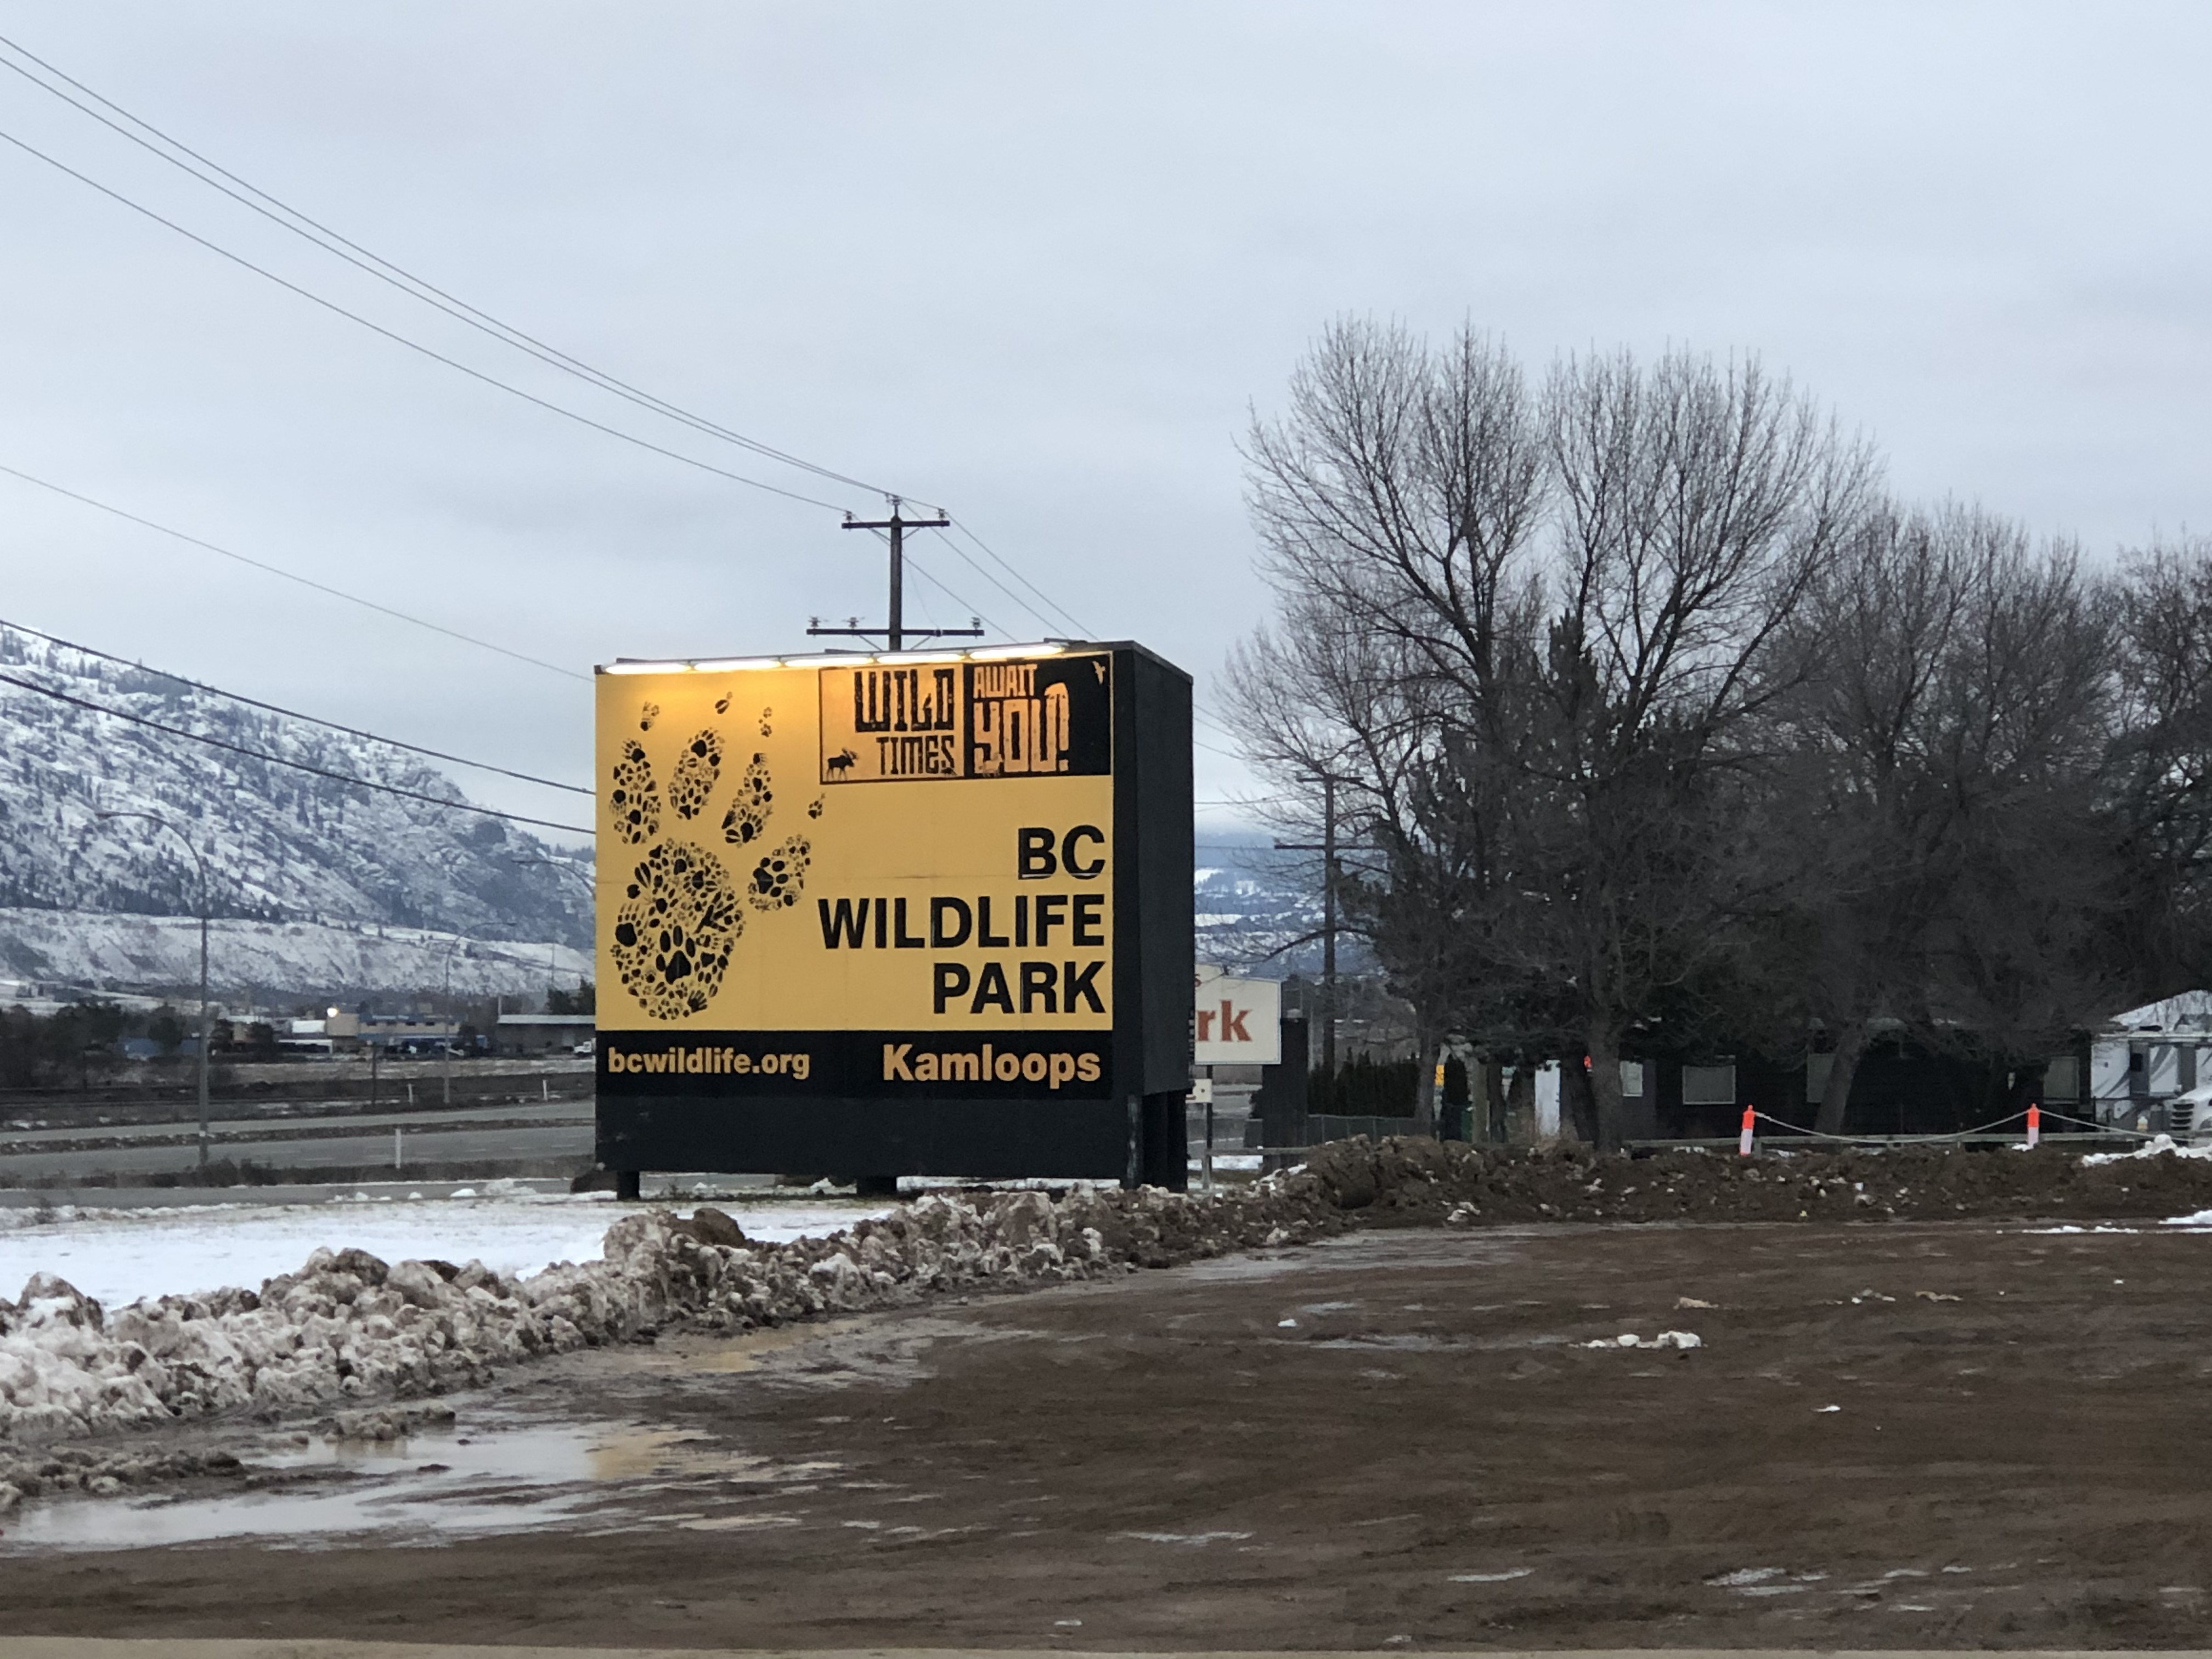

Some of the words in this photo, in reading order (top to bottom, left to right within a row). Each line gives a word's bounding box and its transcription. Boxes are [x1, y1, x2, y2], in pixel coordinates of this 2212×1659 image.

[855, 669, 955, 733] WILD
[973, 664, 1037, 699] AWAIT
[974, 682, 1069, 774] YOU!
[876, 735, 955, 776] TIMES
[1018, 825, 1106, 880] BC
[817, 894, 1105, 950] WILDLIFE
[933, 961, 1106, 1014] PARK
[608, 1046, 810, 1080] bcwildlife.org
[883, 1043, 1101, 1090] Kamloops
